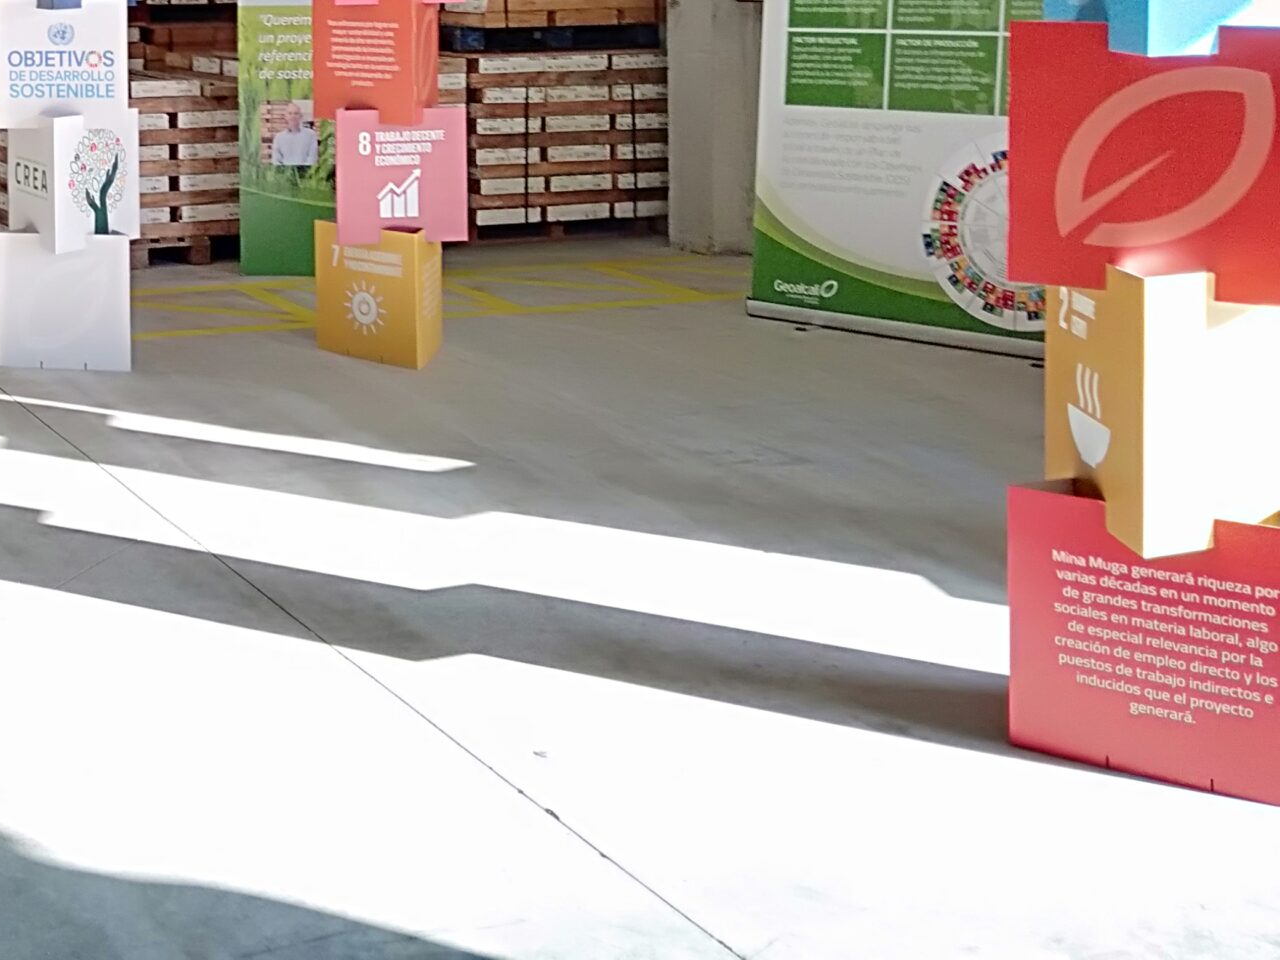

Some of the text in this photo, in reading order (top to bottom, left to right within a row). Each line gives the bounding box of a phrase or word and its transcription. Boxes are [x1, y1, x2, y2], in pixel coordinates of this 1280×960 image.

[8, 50, 115, 68] OBJETIVOS
[259, 33, 312, 47] un proye
[9, 70, 115, 82] DE DESARROLLO
[9, 83, 115, 99] SOSTENIBLE
[259, 68, 274, 79] de
[358, 132, 371, 155] 8
[14, 162, 49, 194] CREA
[1052, 549, 1280, 599] Mina Muga generará riqueza por
[1056, 569, 1276, 617] varias décadas en un momento
[1054, 602, 1278, 654] sociales en materia laboral, algo
[1062, 586, 1269, 633] de grandes transformaciones
[1054, 636, 1278, 688] creación de empleo directo y los
[1067, 620, 1263, 667] de especial relevancia por la
[1058, 653, 1274, 704] puestos de trabajo indirectos e
[1076, 671, 1254, 718] inducidos que el proyecto
[1130, 702, 1196, 724] generará.
